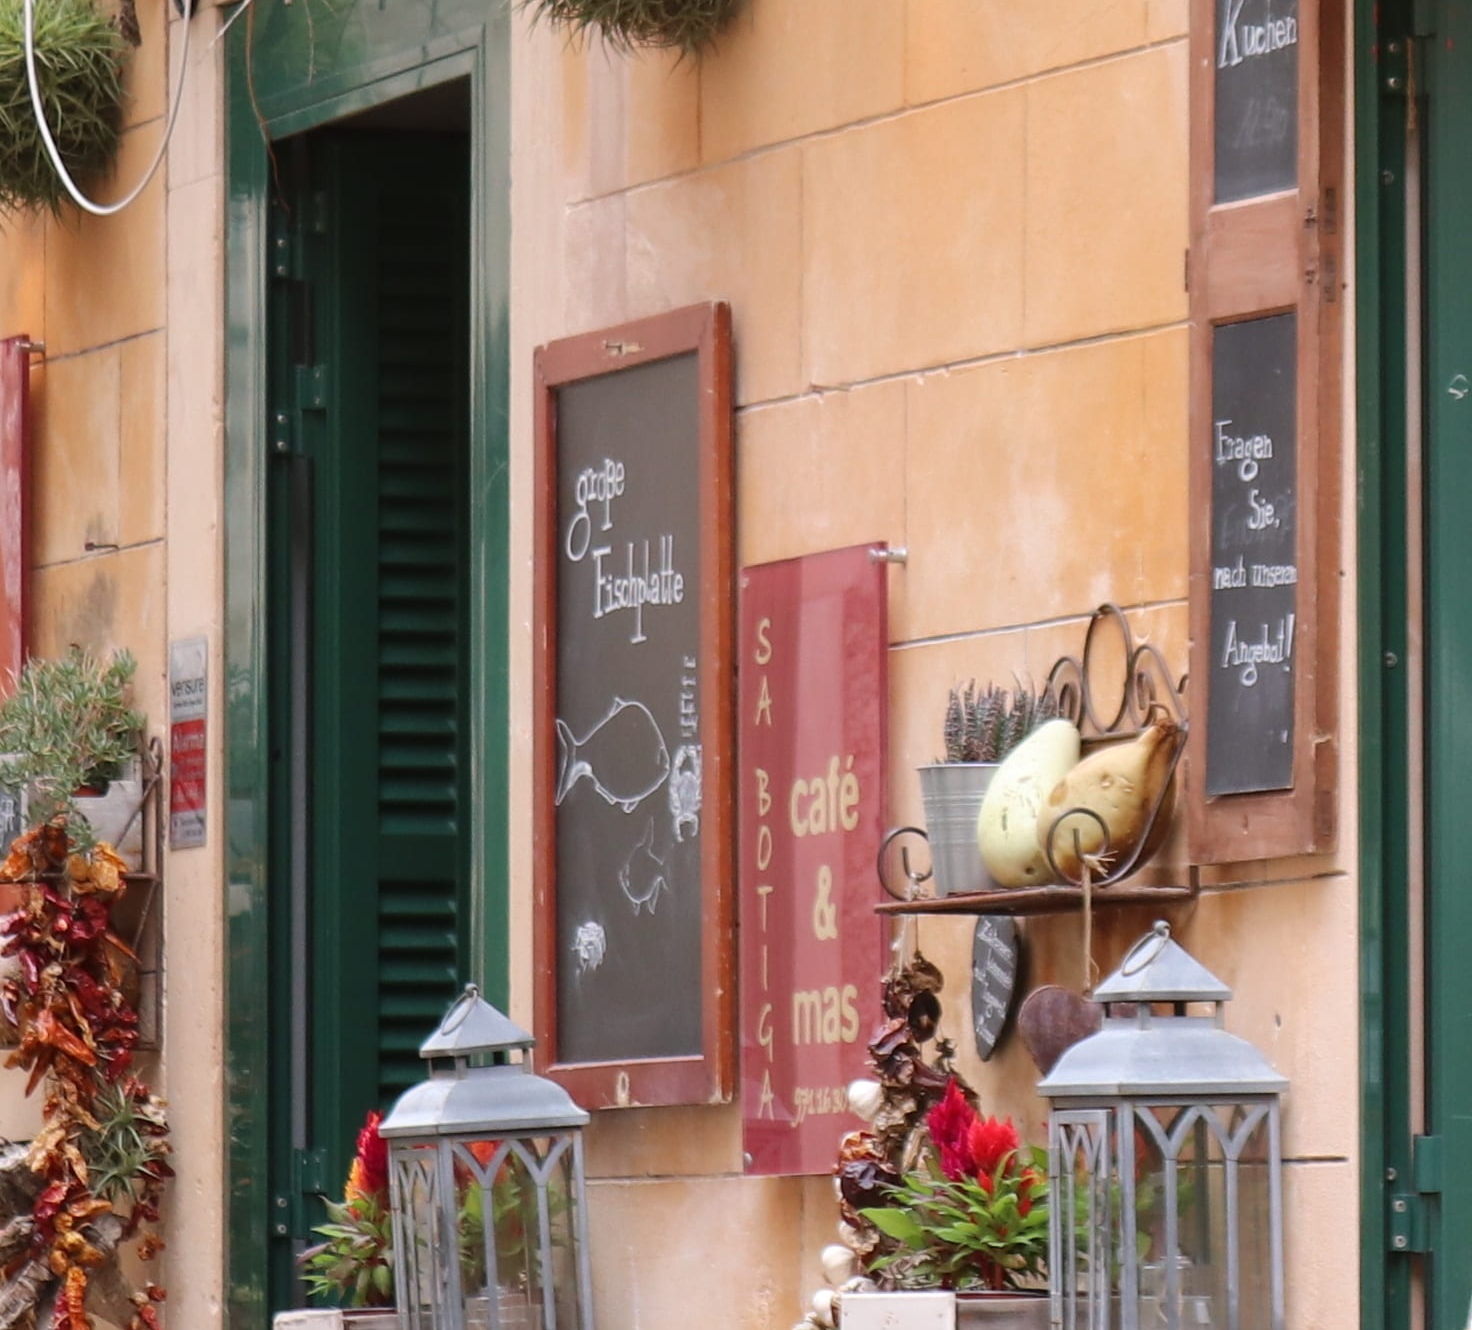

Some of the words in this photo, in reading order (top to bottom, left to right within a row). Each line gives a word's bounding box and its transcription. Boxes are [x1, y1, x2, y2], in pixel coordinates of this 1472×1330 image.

[1215, 419, 1273, 482] Fragen
[566, 456, 626, 562] große
[1247, 488, 1281, 530] Sie,
[591, 534, 685, 644] Fischplatte
[1213, 553, 1247, 589] nach
[789, 753, 861, 838] café
[812, 863, 838, 942] &
[754, 767, 775, 1122] BOTIGA
[791, 982, 861, 1047] mas
